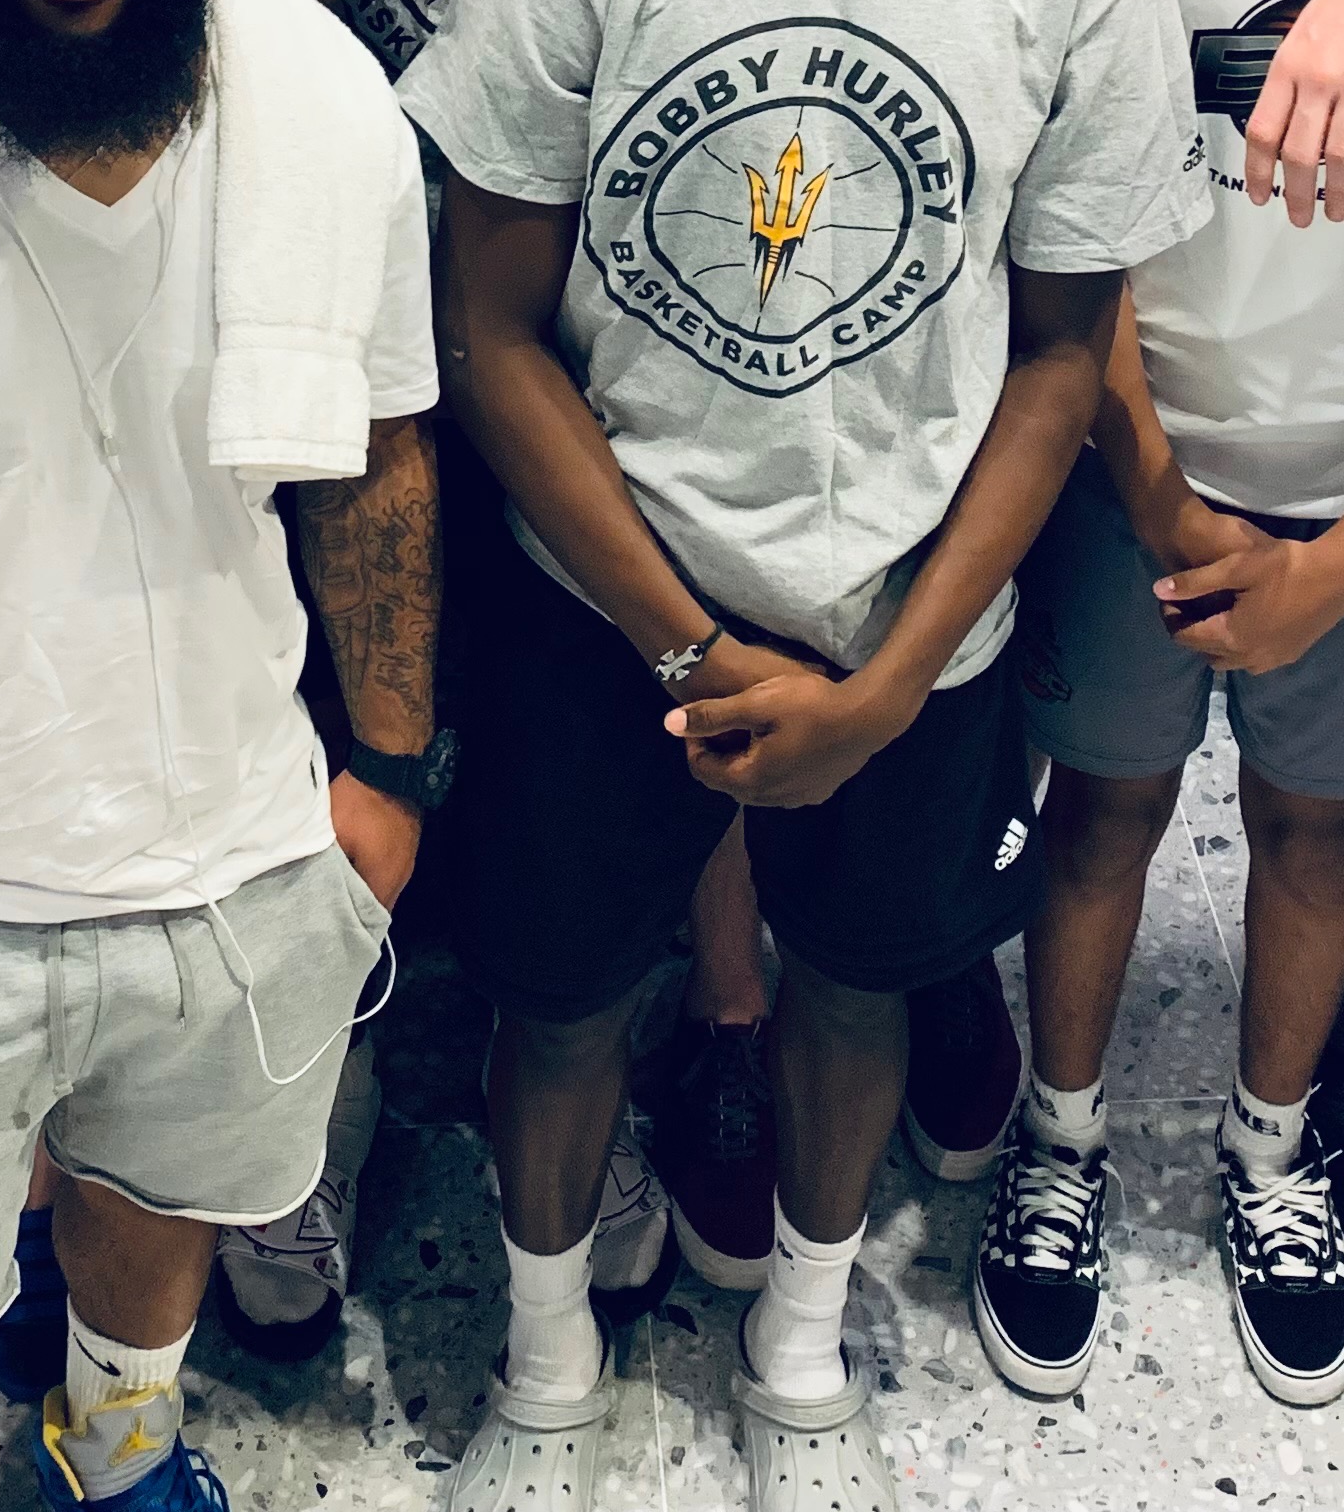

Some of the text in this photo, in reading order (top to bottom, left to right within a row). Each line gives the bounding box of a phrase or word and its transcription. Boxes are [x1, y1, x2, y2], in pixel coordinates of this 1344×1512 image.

[603, 45, 958, 225] BOBBY HURLEY
[609, 240, 929, 378] BASKETBALL CAMP
